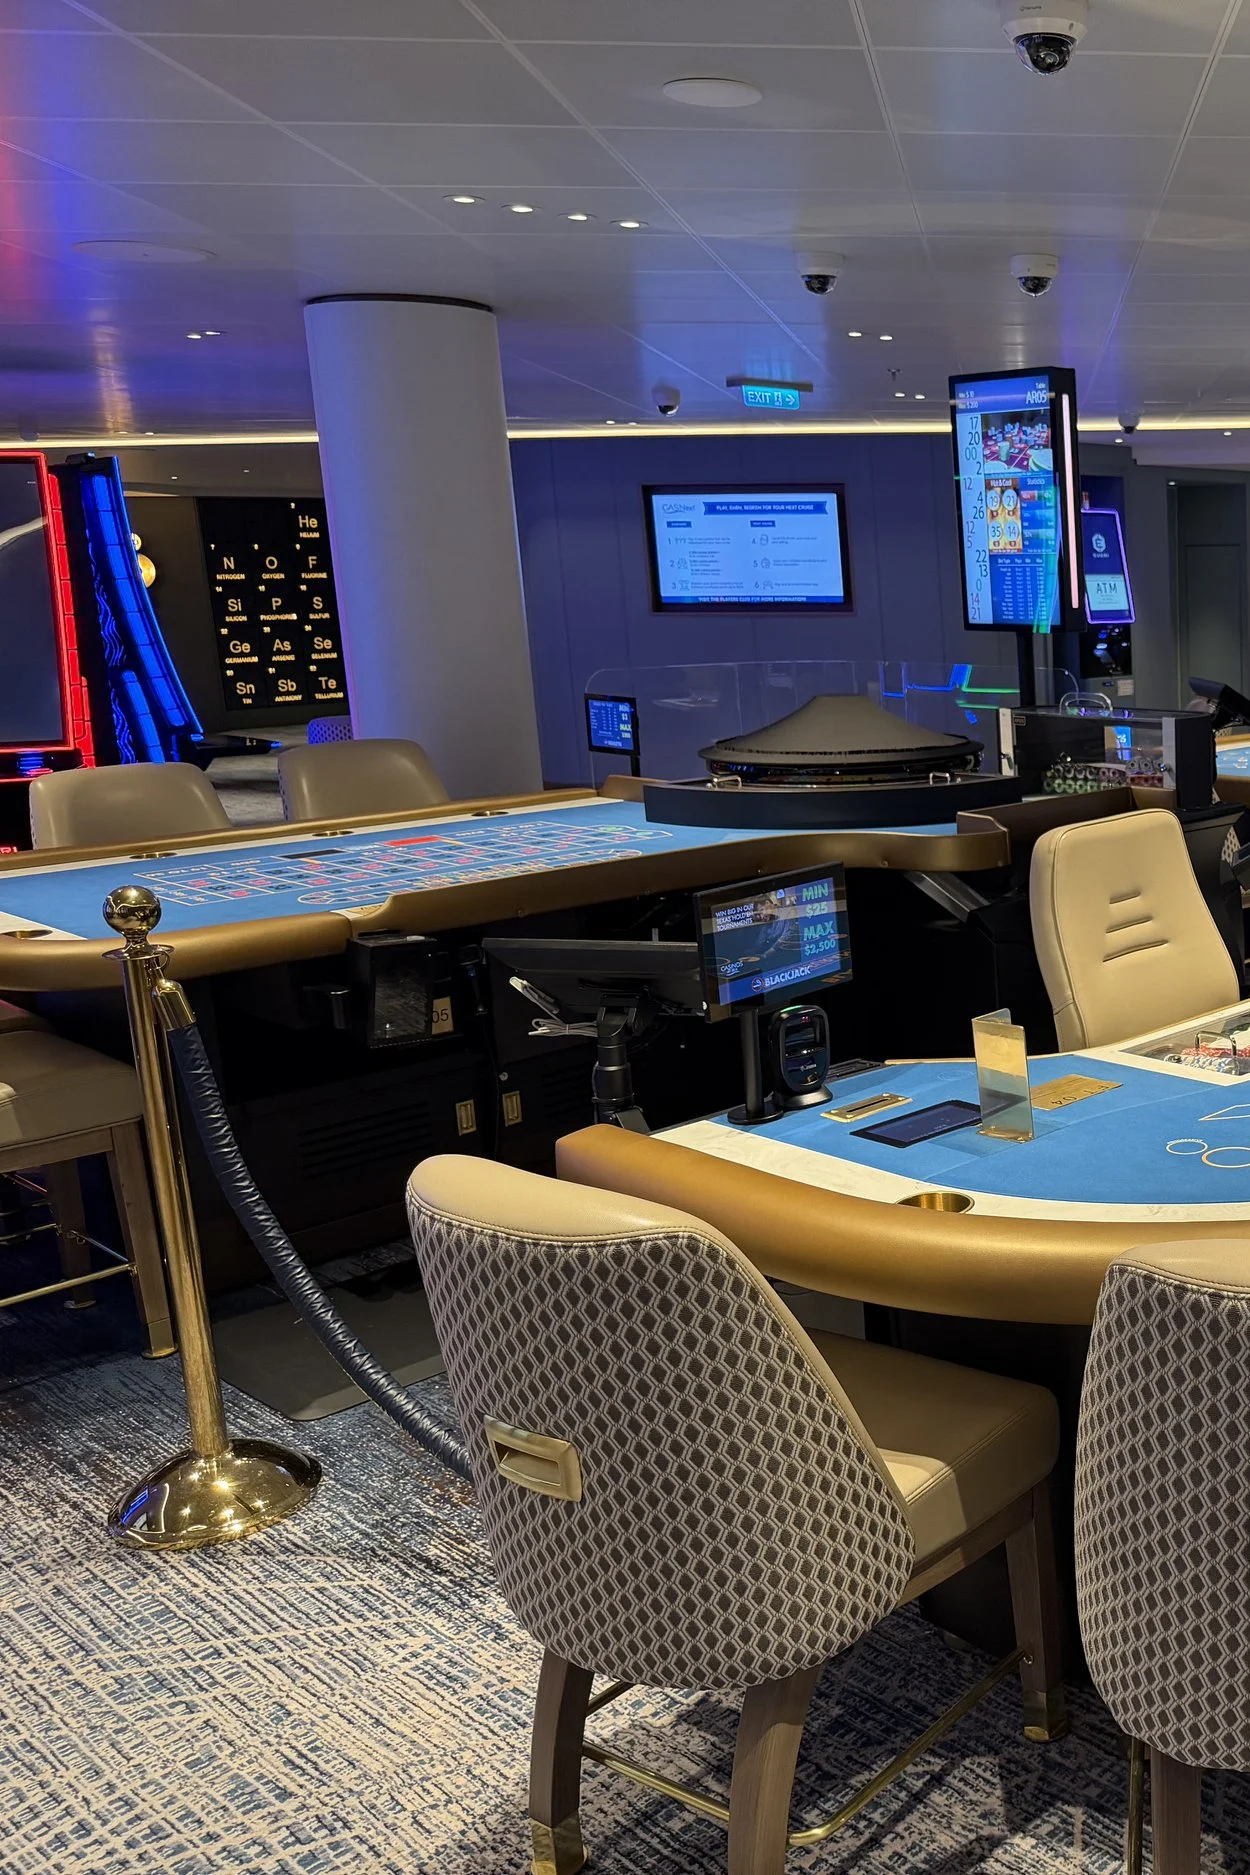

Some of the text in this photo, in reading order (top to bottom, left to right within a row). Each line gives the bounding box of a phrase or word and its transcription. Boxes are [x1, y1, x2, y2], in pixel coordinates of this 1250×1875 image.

[747, 391, 772, 404] EXIT
[1025, 390, 1047, 404] AR05
[970, 416, 979, 430] 17
[968, 431, 980, 446] 20
[965, 446, 978, 461] 00
[976, 461, 982, 475] 2
[963, 477, 973, 490] 12
[977, 491, 983, 505] 4
[990, 496, 999, 507] 19
[1006, 495, 1015, 506] 21
[972, 506, 985, 520] 26
[298, 515, 318, 528] He
[966, 520, 975, 534] 12
[991, 526, 1001, 537] 35
[967, 536, 973, 549] 5
[308, 556, 317, 569] F
[975, 549, 987, 563] 22
[223, 556, 235, 570] N
[265, 556, 278, 570] O
[979, 564, 989, 578] 13
[976, 578, 982, 592] 0
[1096, 582, 1118, 595] ATM
[227, 598, 242, 612] Si
[271, 597, 282, 610] P
[312, 596, 323, 610] S
[970, 593, 980, 606] 14
[971, 607, 981, 620] 21
[229, 640, 251, 653] Ge
[273, 638, 292, 651] As
[313, 636, 333, 650] Se
[225, 656, 259, 664] GERMANIUM
[311, 652, 338, 660] SELENIUM
[236, 682, 256, 695] Sn
[277, 679, 297, 692] Sb
[318, 677, 337, 690] Te
[802, 882, 829, 902] MIN
[715, 908, 727, 918] WIN
[805, 901, 828, 919] $25
[803, 920, 835, 942] MAX
[804, 938, 837, 957] $2,500
[720, 960, 744, 972] CASINOS
[764, 966, 811, 987] BLACKJACK
